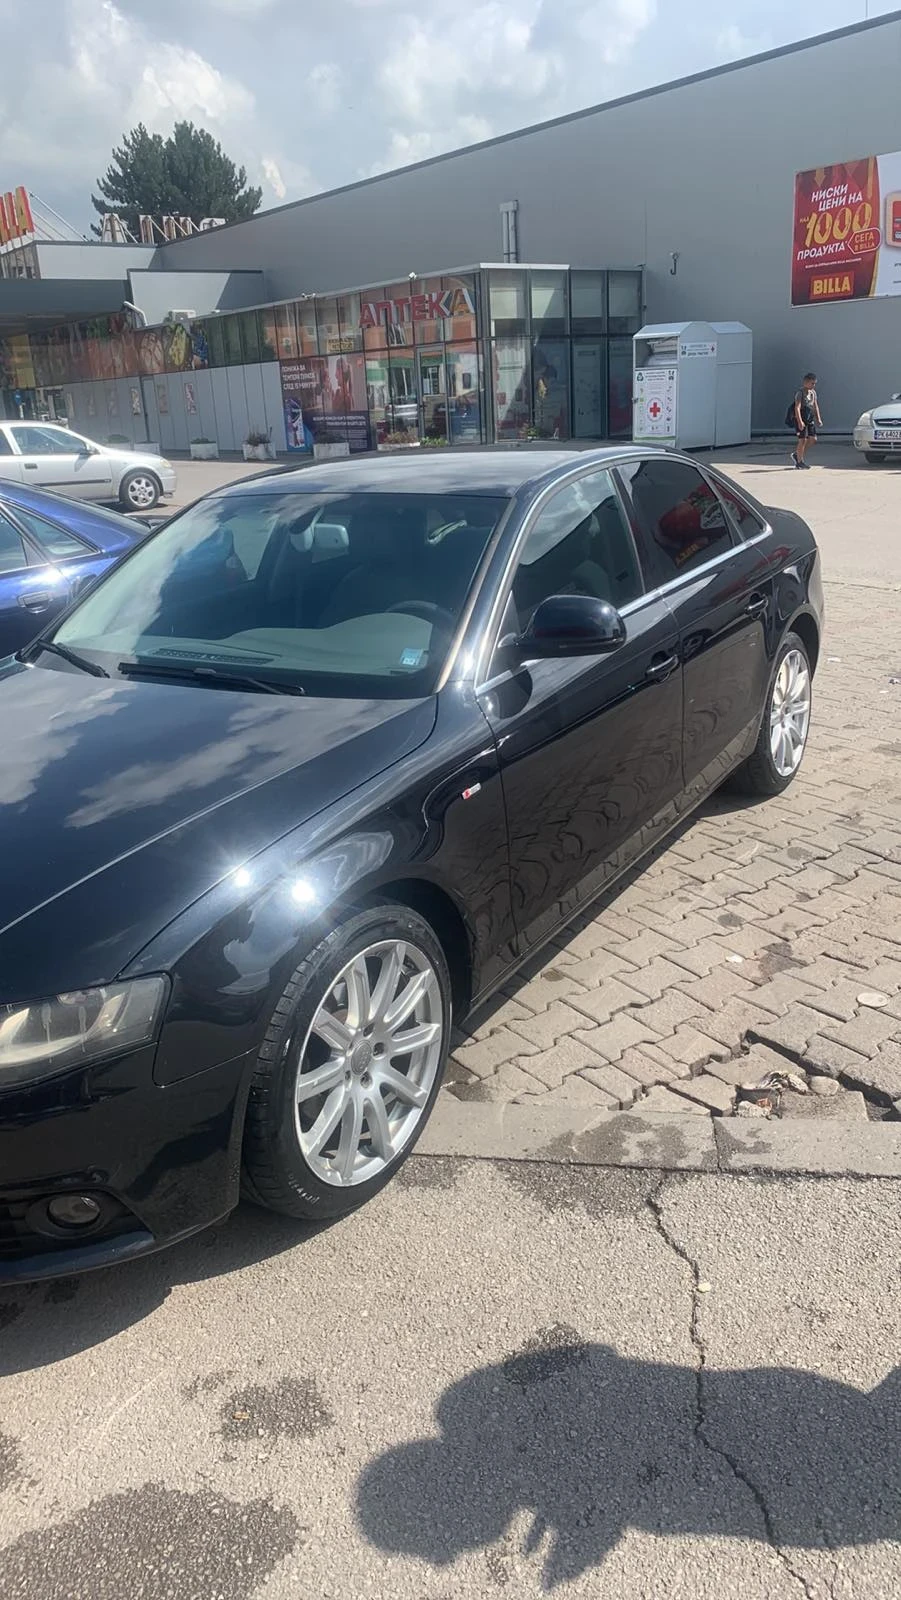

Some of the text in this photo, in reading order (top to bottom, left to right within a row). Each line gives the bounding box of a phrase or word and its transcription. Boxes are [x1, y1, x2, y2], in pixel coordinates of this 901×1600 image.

[811, 184, 848, 202] НИСКИ
[818, 191, 863, 212] ЦЕНИ НА
[805, 202, 872, 248] 1000
[854, 231, 875, 243] СЕГА
[813, 276, 851, 295] BILLA
[359, 287, 476, 329] АПТЕКА
